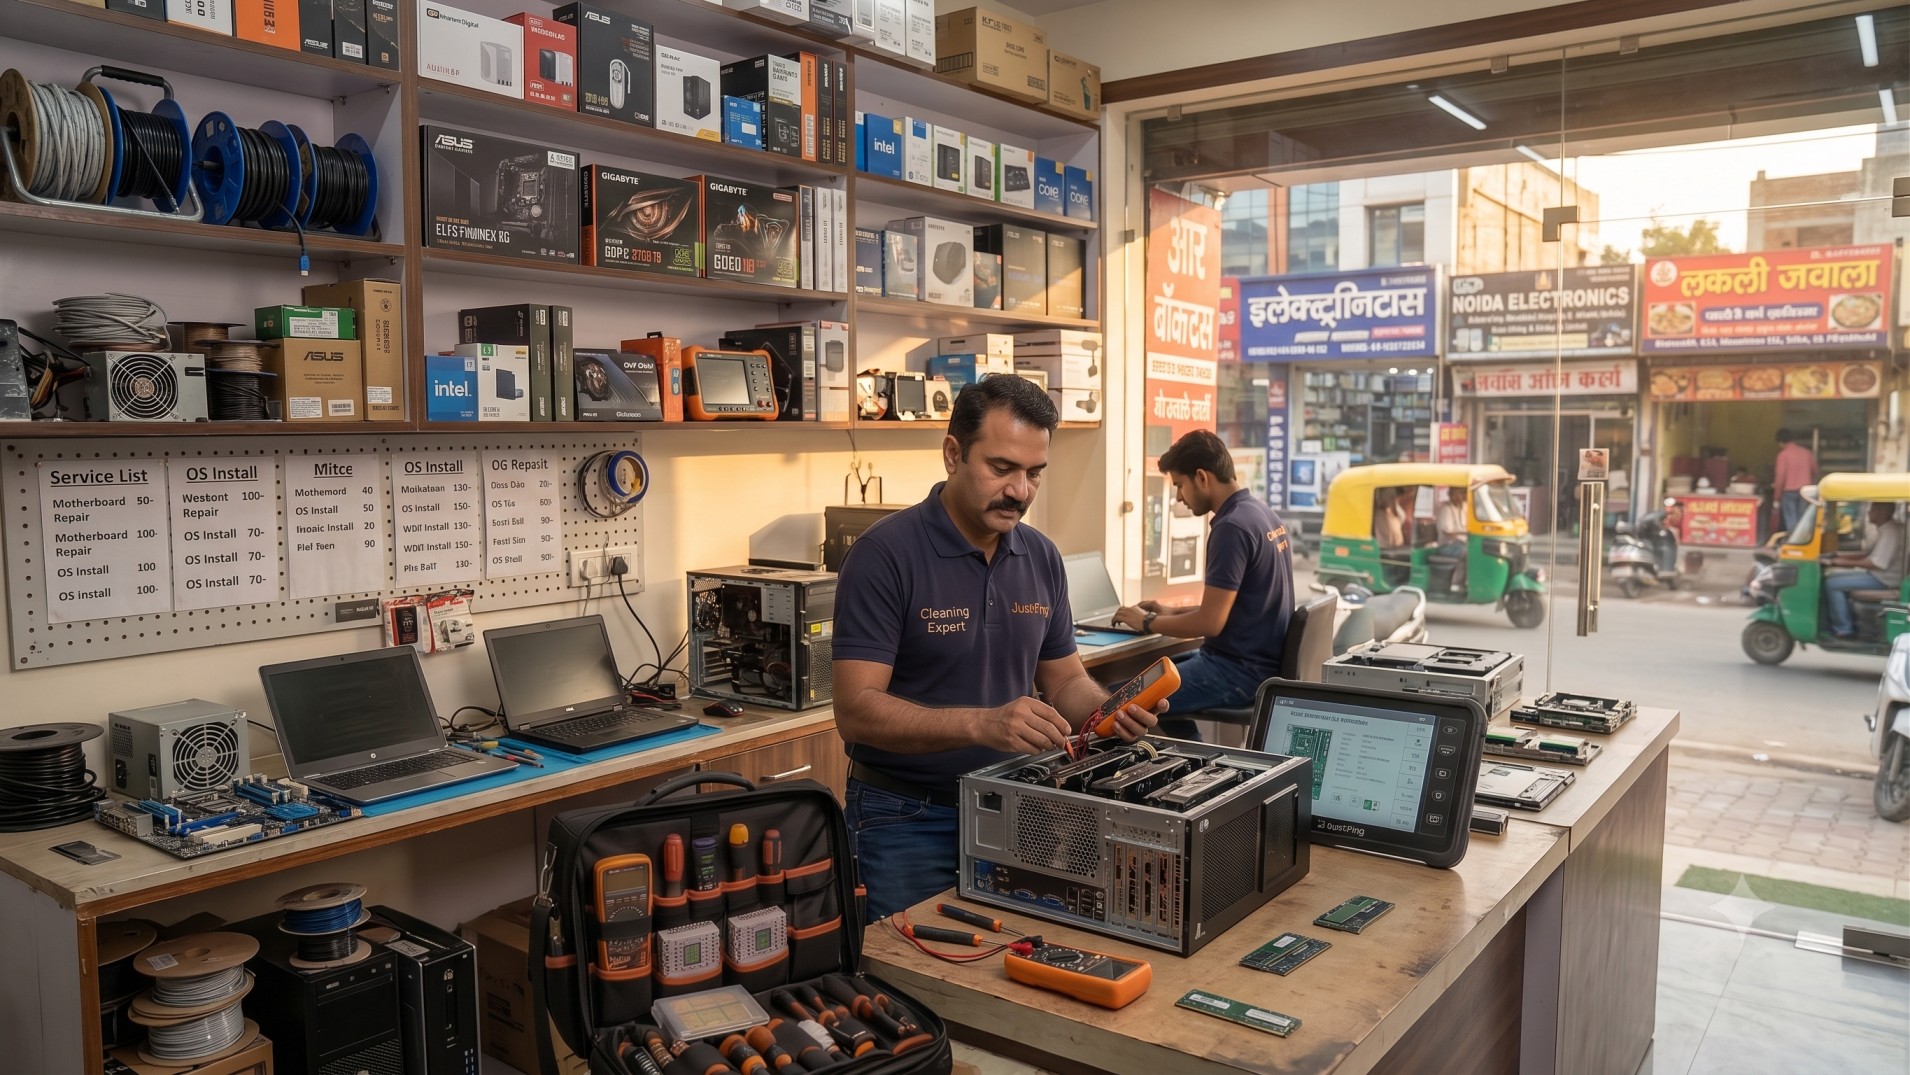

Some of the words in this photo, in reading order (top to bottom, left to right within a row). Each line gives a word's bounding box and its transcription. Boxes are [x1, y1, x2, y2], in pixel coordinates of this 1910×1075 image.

[585, 11, 611, 25] ASUS
[435, 134, 473, 149] ASUS
[874, 138, 895, 155] intel
[601, 172, 639, 185] GIGABYTE
[709, 182, 747, 196] GIGABYTE
[1453, 294, 1505, 314] NOIDA
[1508, 287, 1630, 311] ELECTRONICS
[304, 352, 344, 362] ASUS
[404, 461, 422, 473] OS
[426, 459, 463, 473] Install
[50, 469, 114, 485] Service
[120, 468, 148, 483] List
[186, 467, 208, 481] OS
[212, 465, 258, 480] Install
[362, 486, 373, 494] 40
[53, 496, 126, 509] Motherboard
[401, 504, 413, 513] OS
[415, 503, 440, 512] Install
[183, 507, 219, 519] Repair
[295, 507, 308, 516] OS
[311, 505, 338, 515] Install
[363, 504, 374, 512] 50
[54, 512, 90, 525] Repair
[327, 522, 354, 532] Install
[364, 521, 375, 530] 20
[424, 522, 449, 531] Install
[55, 530, 128, 543] Motherboard
[184, 531, 200, 541] OS
[203, 528, 237, 540] Install
[364, 540, 375, 548] 90
[426, 541, 451, 551] Install
[56, 545, 92, 558] Repair
[185, 555, 201, 565] OS
[204, 552, 238, 564] Install
[57, 567, 73, 578] OS
[75, 565, 109, 577] Install
[137, 562, 156, 572] 100
[186, 579, 202, 589] OS
[205, 576, 239, 588] Install
[59, 591, 75, 601] OS
[920, 606, 970, 620] Cleaning
[927, 621, 966, 635] Expert
